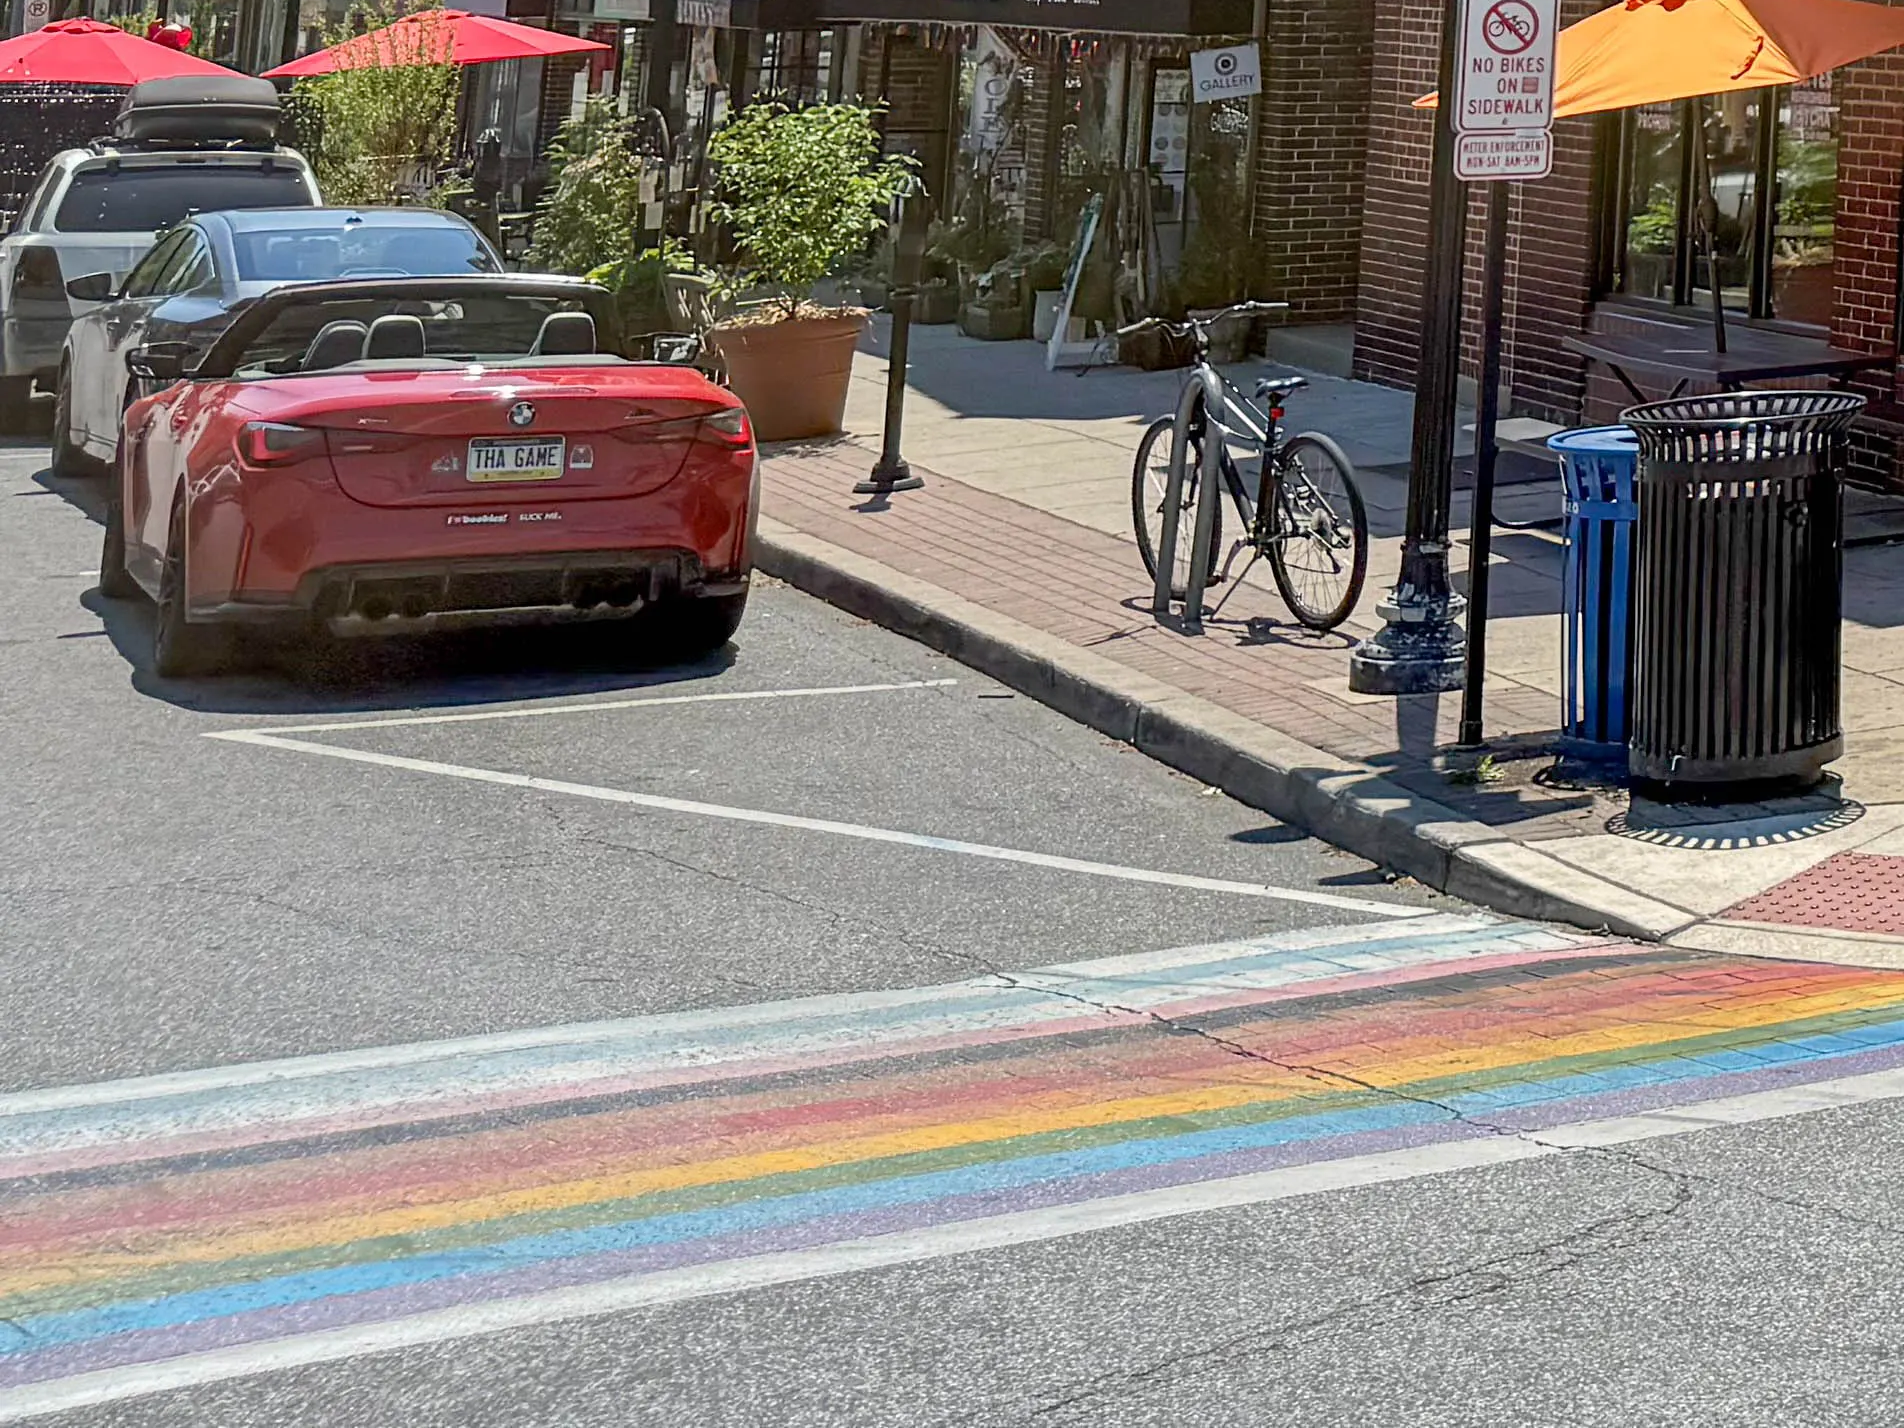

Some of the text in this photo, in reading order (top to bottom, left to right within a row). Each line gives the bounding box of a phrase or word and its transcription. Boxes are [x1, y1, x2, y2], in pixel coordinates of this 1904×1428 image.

[1472, 57, 1545, 74] NO BIKES
[1200, 73, 1256, 92] GALLERY
[1497, 78, 1518, 94] ON
[1467, 98, 1544, 116] SIDEWALK
[1463, 139, 1545, 154] METER ENFORCEMENT
[475, 446, 560, 469] THA GAME
